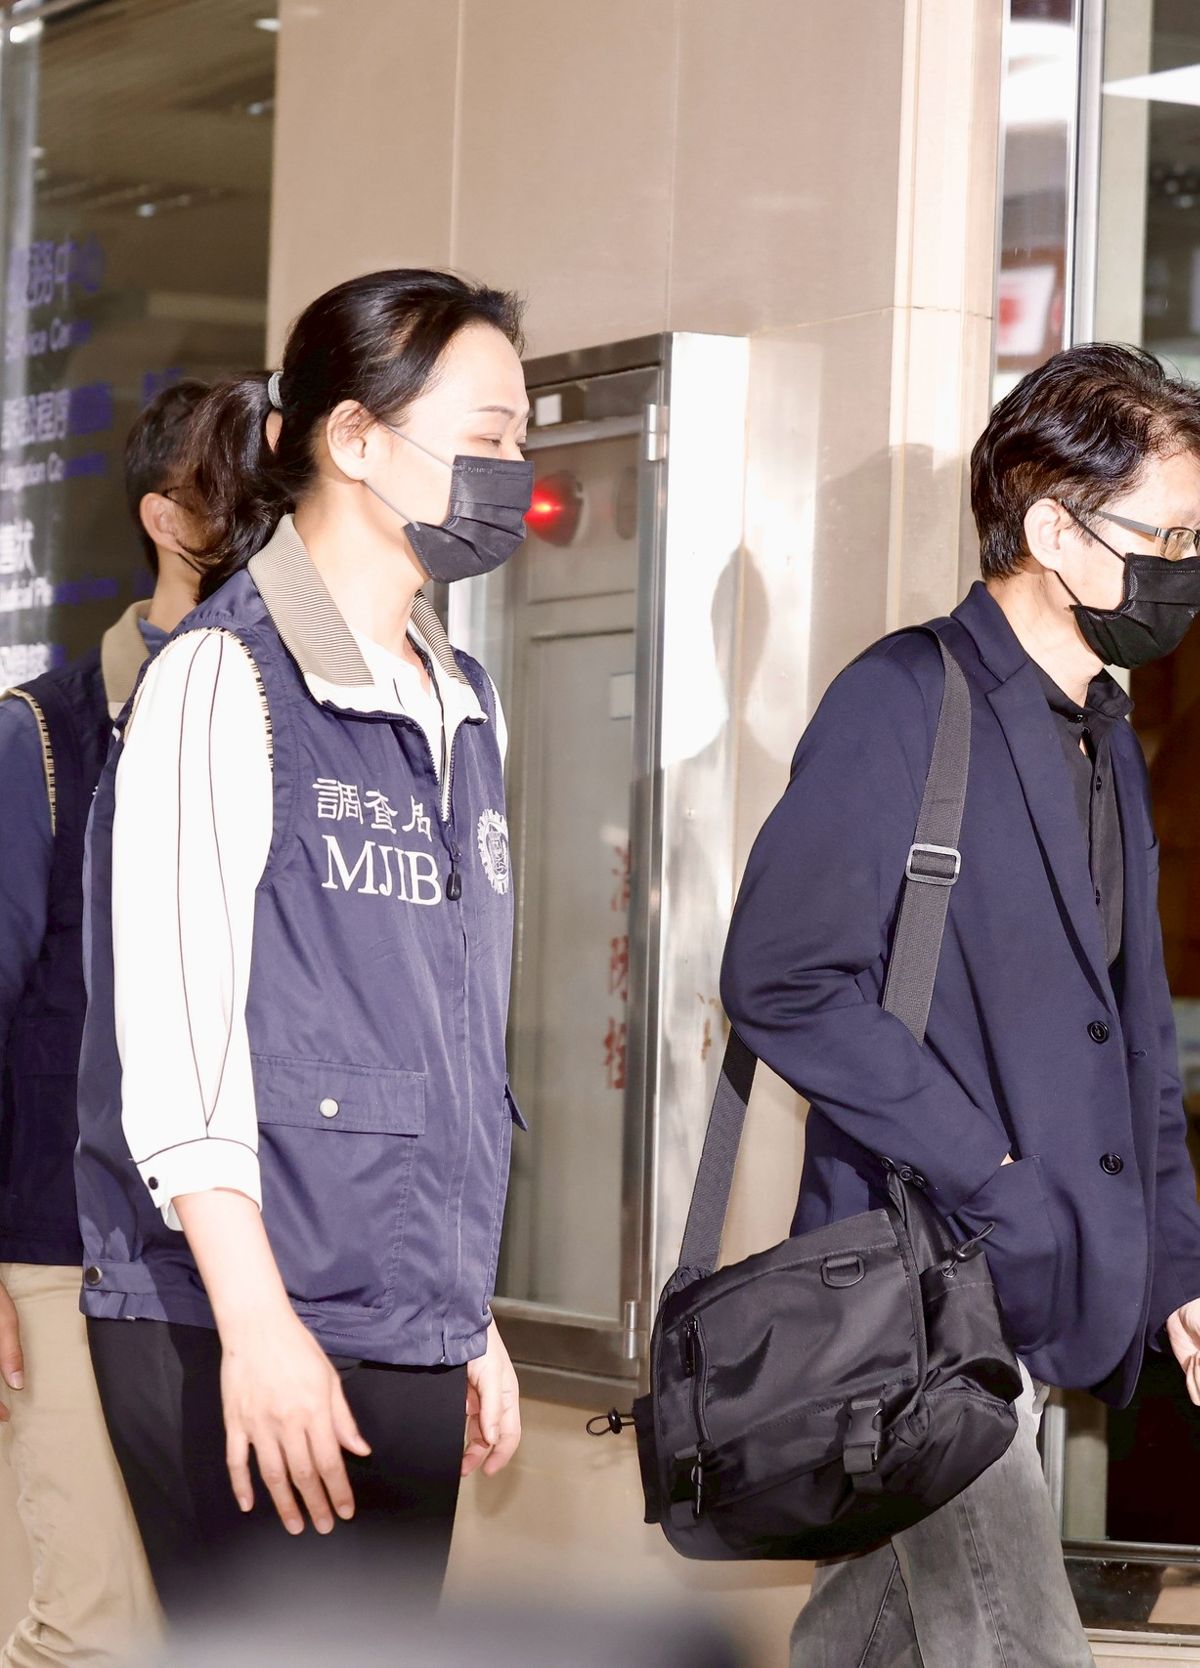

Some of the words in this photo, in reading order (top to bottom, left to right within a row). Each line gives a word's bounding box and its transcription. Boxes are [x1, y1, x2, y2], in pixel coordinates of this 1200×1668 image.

[312, 777, 432, 842] 調查局
[321, 834, 442, 906] MJIB
